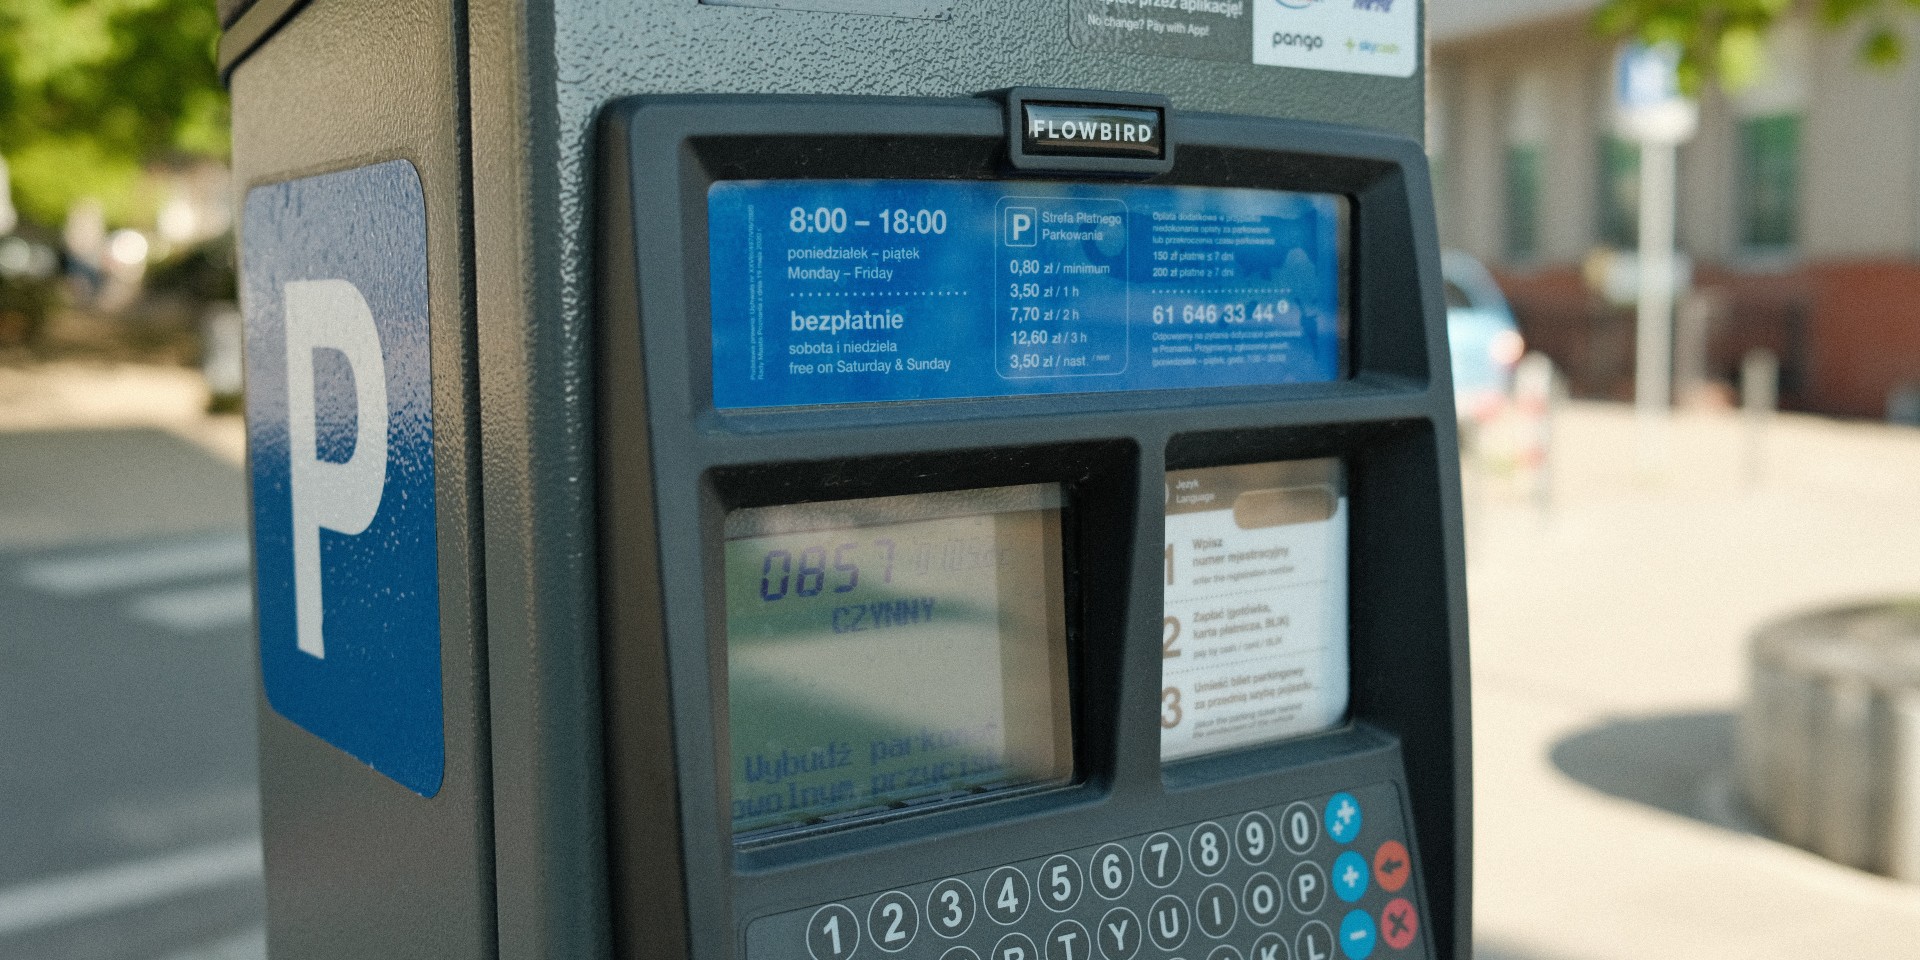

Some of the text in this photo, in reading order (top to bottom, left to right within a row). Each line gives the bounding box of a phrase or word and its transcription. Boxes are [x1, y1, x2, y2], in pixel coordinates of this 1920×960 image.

[1087, 14, 1210, 38] No change? Pay with App!
[1273, 32, 1323, 51] pango
[1033, 119, 1151, 143] FLOWBIRD
[789, 207, 847, 233] 8:00
[879, 209, 947, 234] 18:00
[1013, 214, 1031, 240] P
[1042, 211, 1122, 226] Strefa Płatnego
[1042, 229, 1103, 241] Parkowania
[1152, 236, 1164, 244] lub
[787, 246, 868, 262] poniedziałek
[882, 247, 920, 263] piątek
[1153, 251, 1168, 260] 150
[1170, 251, 1178, 260] zł
[1221, 251, 1234, 261] dni
[787, 266, 840, 282] Monday
[855, 266, 893, 282] Friday
[1010, 260, 1040, 276] 0,80
[1044, 262, 1054, 274] zł
[1063, 263, 1110, 274] minimum
[1153, 267, 1168, 277] 200
[1170, 267, 1178, 277] zł
[1221, 267, 1234, 277] dni
[1010, 283, 1040, 300] 3,50
[1044, 285, 1054, 297] zł
[1063, 286, 1068, 297] 1
[1072, 285, 1079, 297] h
[791, 309, 904, 336] bezpłatnie
[1010, 307, 1040, 323] 7,70
[1044, 308, 1054, 320] zł
[1063, 309, 1070, 320] 2
[1072, 309, 1079, 320] h
[1153, 304, 1274, 325] 61 646 33 44
[1010, 330, 1048, 347] 12,60
[1052, 332, 1062, 344] zł
[1071, 332, 1078, 343] 3
[1080, 332, 1087, 343] h
[789, 342, 833, 355] sobota
[844, 340, 898, 353] niedziela
[789, 358, 951, 375] free on Saturday & Sunday
[1010, 354, 1040, 371] 3,50
[1043, 356, 1054, 367] zł
[285, 278, 388, 659] P
[1176, 479, 1199, 491] Język
[1176, 493, 1215, 504] Language
[1192, 538, 1223, 551] Wpisz
[760, 537, 896, 602] 0857
[1165, 543, 1174, 586] 1
[831, 597, 937, 635] CZYNNY
[1163, 616, 1181, 658] 2
[1161, 686, 1182, 729] 3
[823, 811, 1309, 954] 1 2 3 4 5 6 7 8 9 0
[1058, 933, 1077, 960] T
[1108, 919, 1129, 950] Y
[1159, 907, 1179, 938] U
[1213, 897, 1221, 925] I
[1252, 885, 1273, 914] O
[1299, 873, 1316, 903] P
